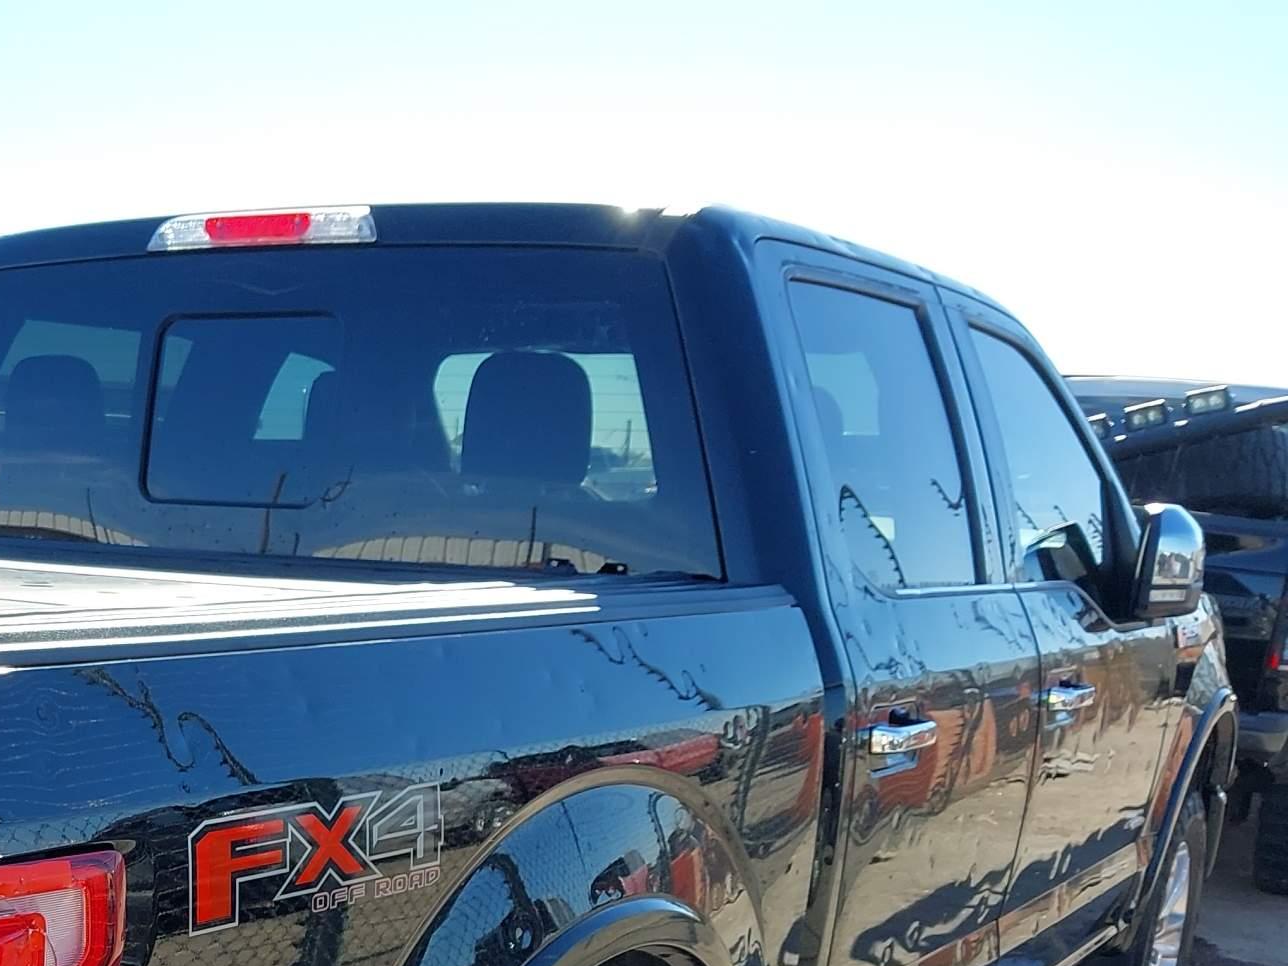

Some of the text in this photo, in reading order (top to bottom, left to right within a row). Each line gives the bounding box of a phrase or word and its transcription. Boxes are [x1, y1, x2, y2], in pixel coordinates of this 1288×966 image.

[188, 782, 444, 937] FX4
[312, 866, 441, 913] OFF ROAD
